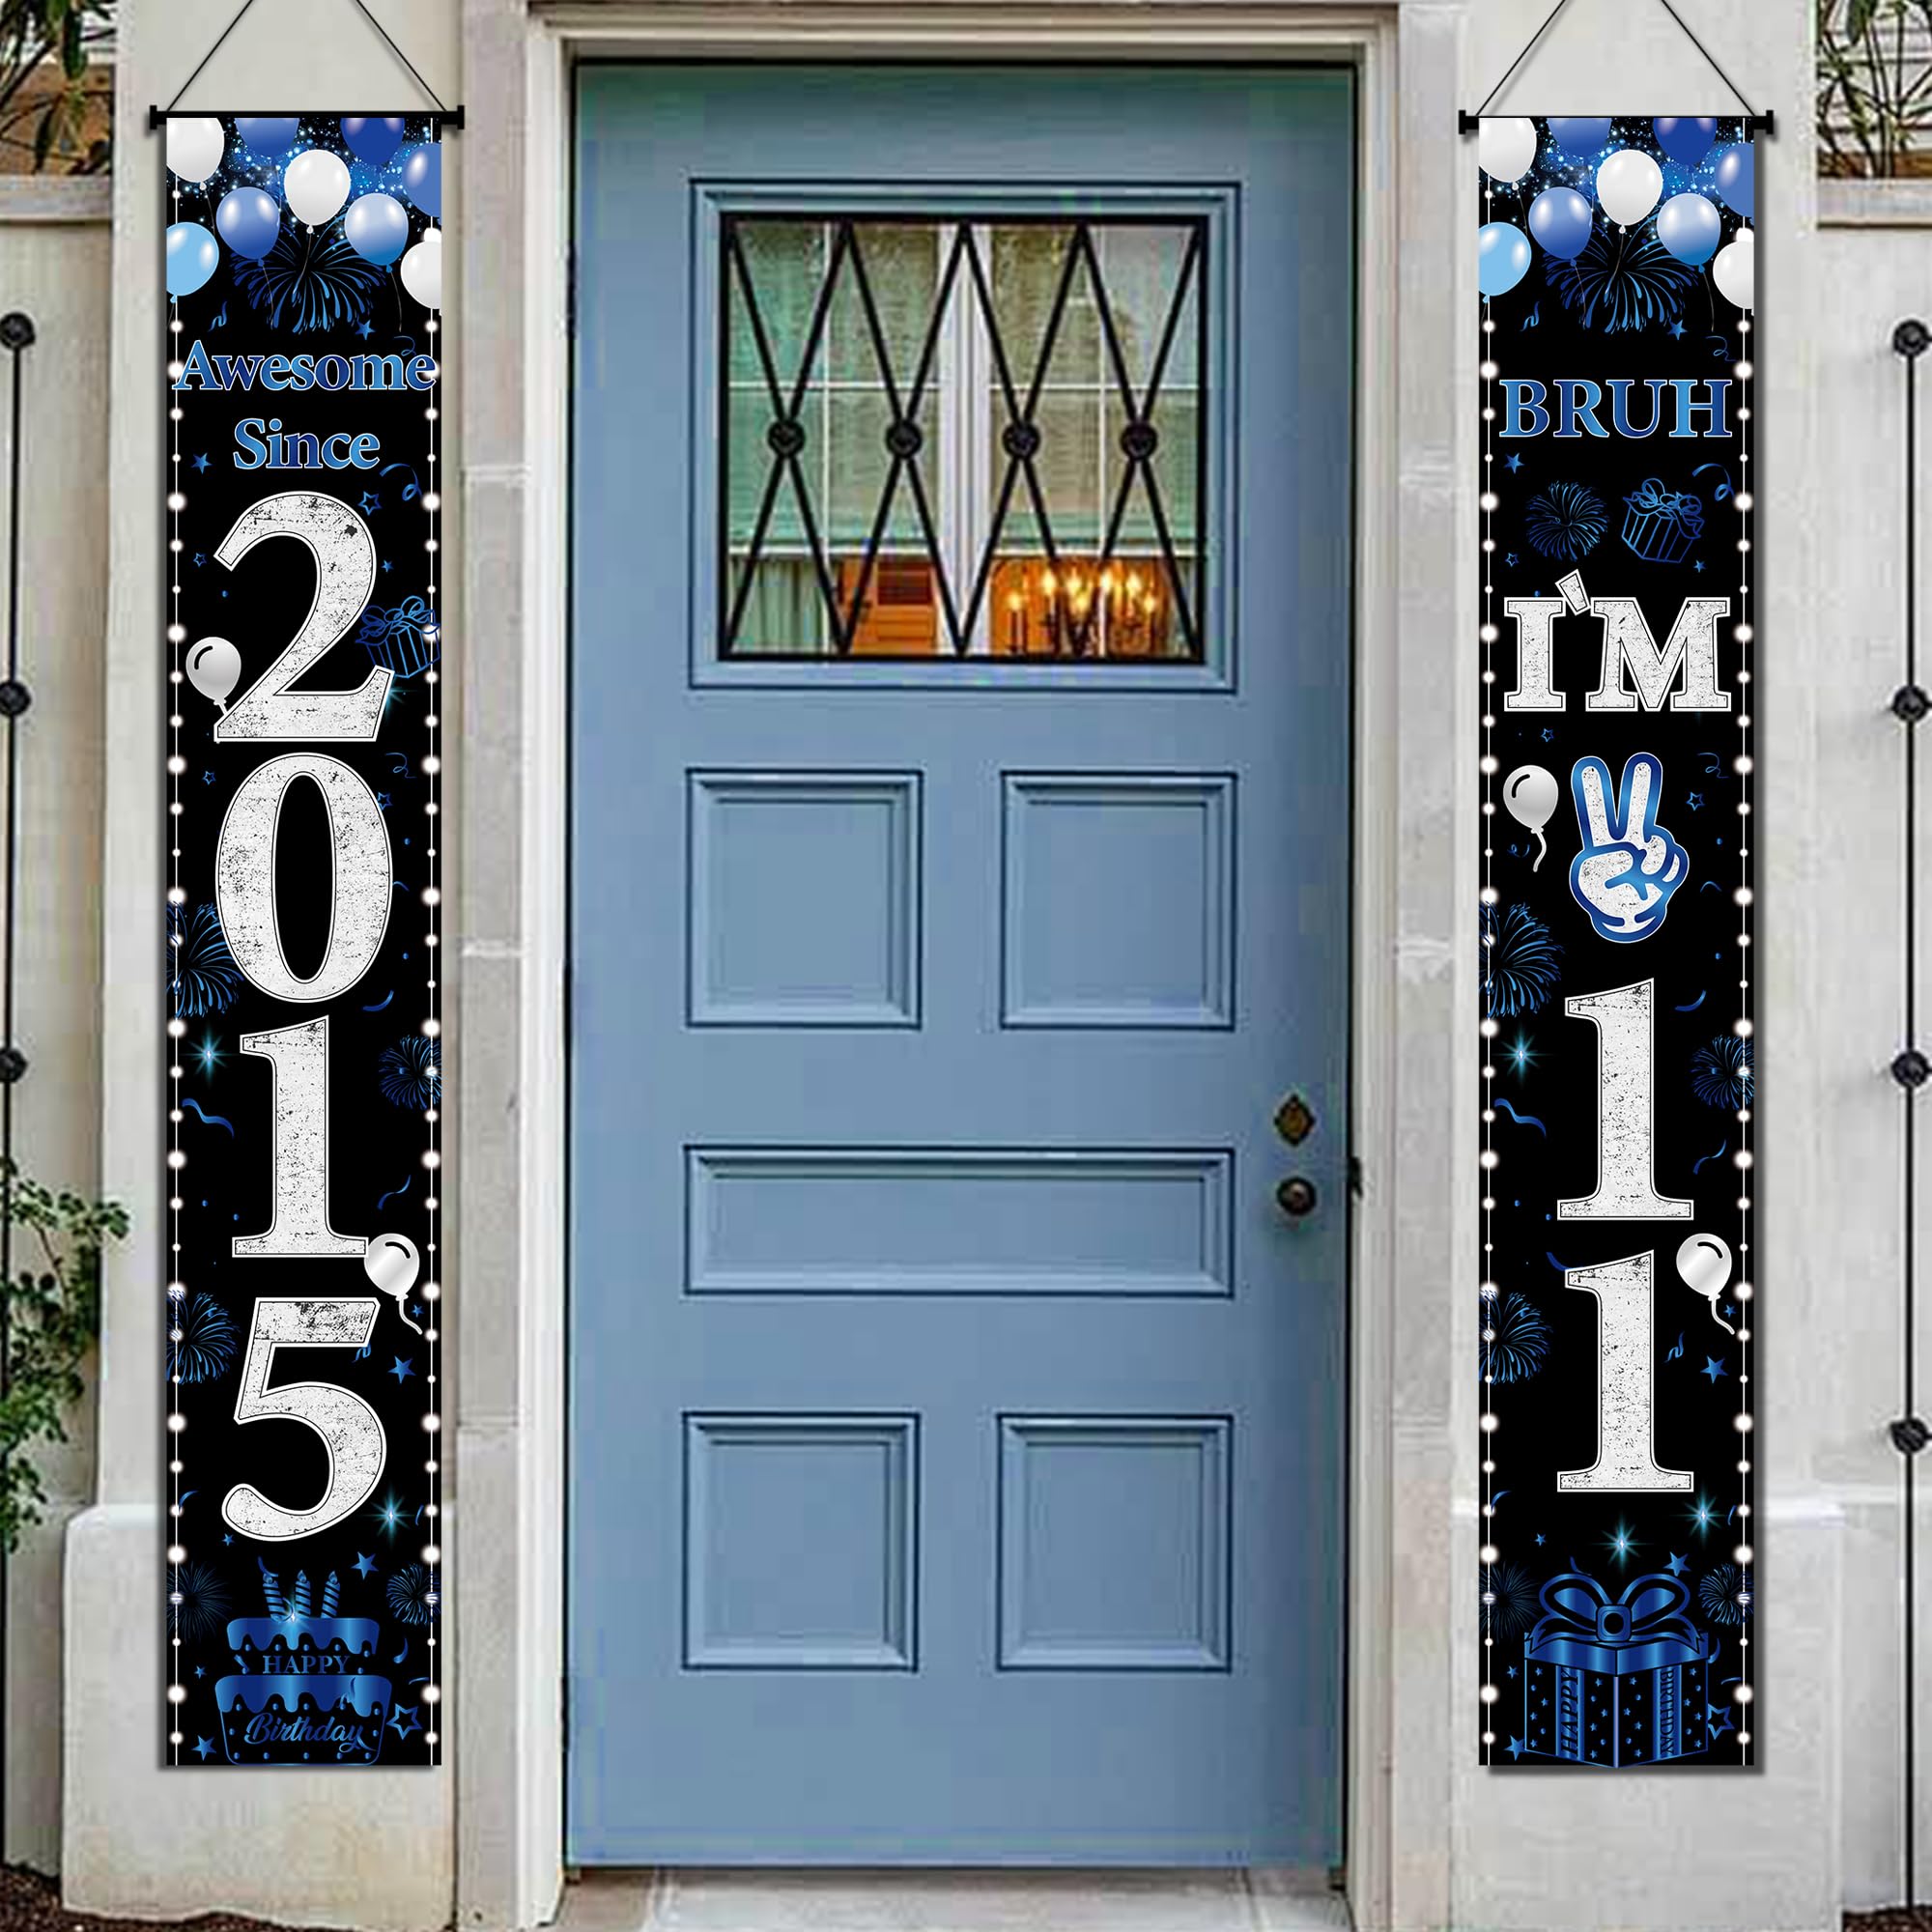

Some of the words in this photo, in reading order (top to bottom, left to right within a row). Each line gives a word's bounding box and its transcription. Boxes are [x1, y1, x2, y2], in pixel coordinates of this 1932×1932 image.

[172, 340, 437, 390] Awesome
[233, 418, 381, 469] Since
[1499, 379, 1733, 438] BRUH
[1504, 569, 1732, 712] I'M
[213, 491, 395, 1542] 2015
[1557, 978, 1694, 1492] 11
[262, 1655, 351, 1674] HAPPY
[243, 1712, 364, 1753] Birthday
[1561, 1667, 1578, 1757] HAPPY
[1661, 1669, 1675, 1755] BIRTHDAY
